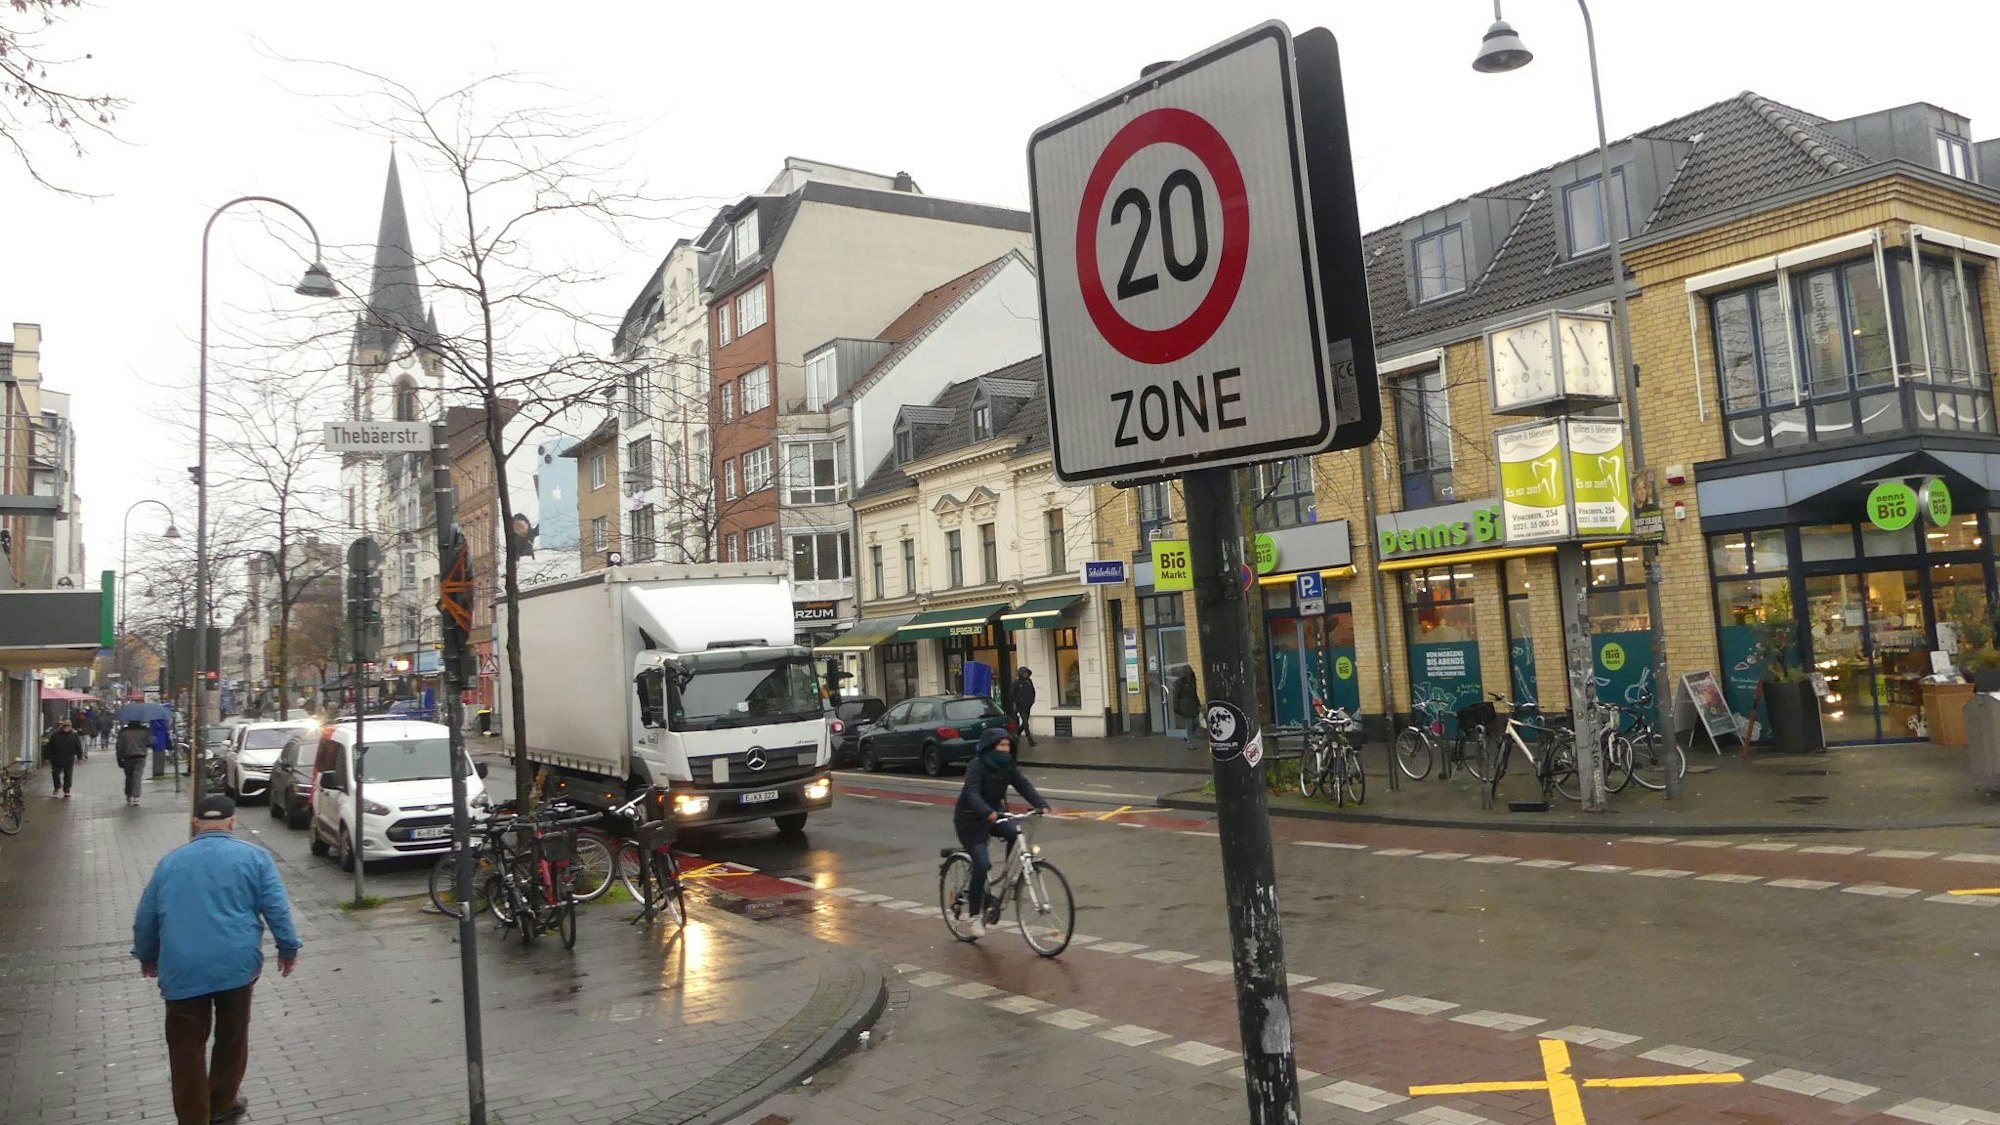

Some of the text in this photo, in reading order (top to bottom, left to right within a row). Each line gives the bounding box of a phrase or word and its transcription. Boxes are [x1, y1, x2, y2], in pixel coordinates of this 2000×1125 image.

[1110, 168, 1208, 301] 20
[1110, 367, 1247, 448] ZONE
[332, 426, 423, 443] Thebäerstr.
[1545, 508, 1558, 517] 254
[1604, 506, 1616, 514] 254
[1538, 520, 1550, 528] 000
[1160, 551, 1186, 569] Bio
[1161, 571, 1187, 579] Markt
[1300, 575, 1315, 597] P
[1437, 657, 1465, 665] ABENDS
